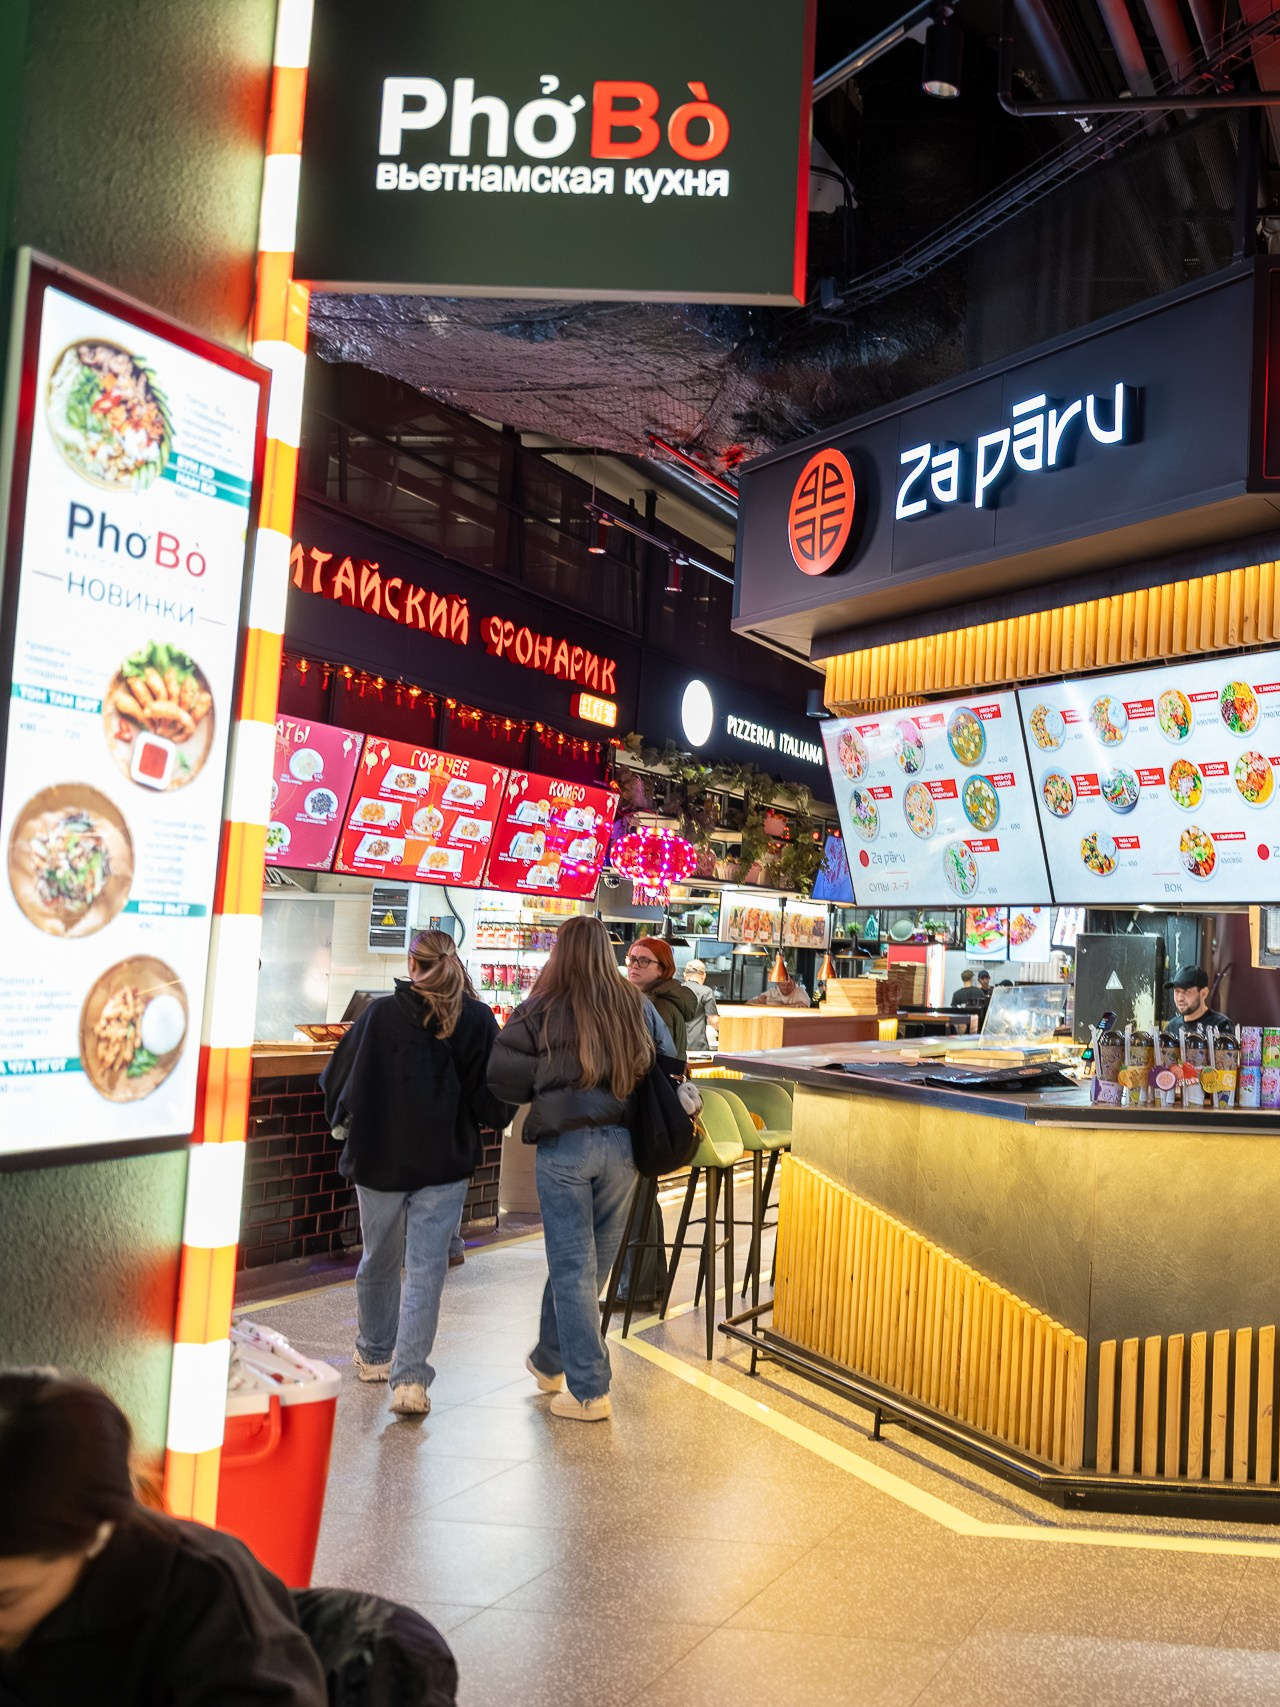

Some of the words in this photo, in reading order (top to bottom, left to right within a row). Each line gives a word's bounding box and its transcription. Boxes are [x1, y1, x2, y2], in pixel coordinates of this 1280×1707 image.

[376, 163, 613, 196] вьетнамская
[624, 168, 730, 203] кухня
[896, 442, 959, 520] Za
[67, 571, 195, 625] НОВИНКИ
[290, 542, 469, 645] ИТАЙСКИЙ
[488, 615, 616, 694] ФОНАРИК
[276, 719, 311, 744] АТЫ
[727, 715, 775, 749] PIZZERIA
[779, 733, 823, 766] ITALIANA
[410, 750, 470, 778] ГОРЯЧЕЕ
[549, 781, 585, 802] КОМБО
[871, 852, 882, 864] Za
[869, 883, 889, 892] СУПЫ
[1164, 883, 1183, 892] ВОК
